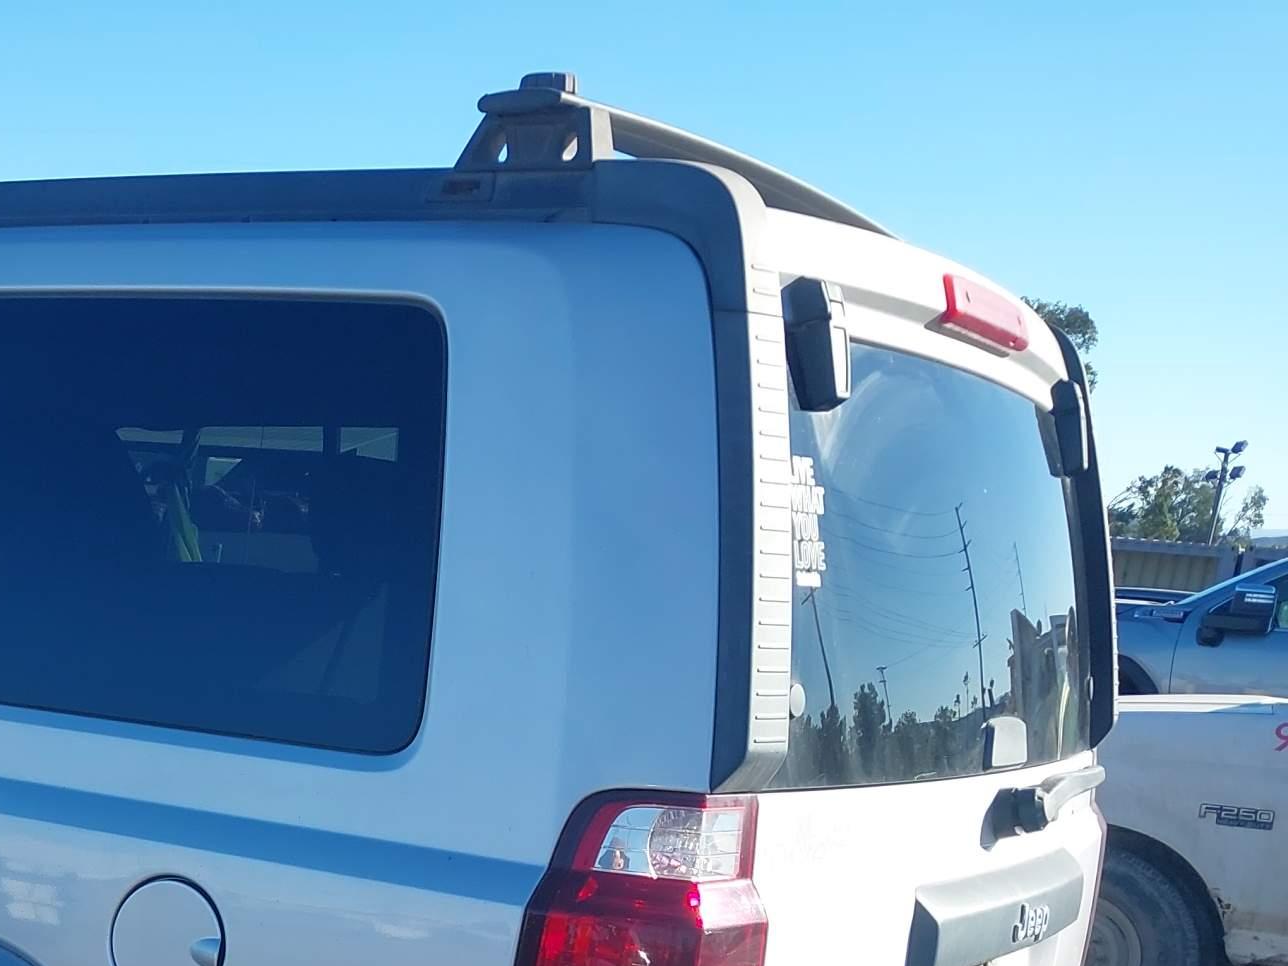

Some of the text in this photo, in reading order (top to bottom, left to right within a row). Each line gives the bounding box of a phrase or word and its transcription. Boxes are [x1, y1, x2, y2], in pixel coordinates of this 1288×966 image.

[792, 511, 819, 541] YOU
[794, 540, 827, 571] LOVE
[1011, 903, 1050, 944] Jeep
